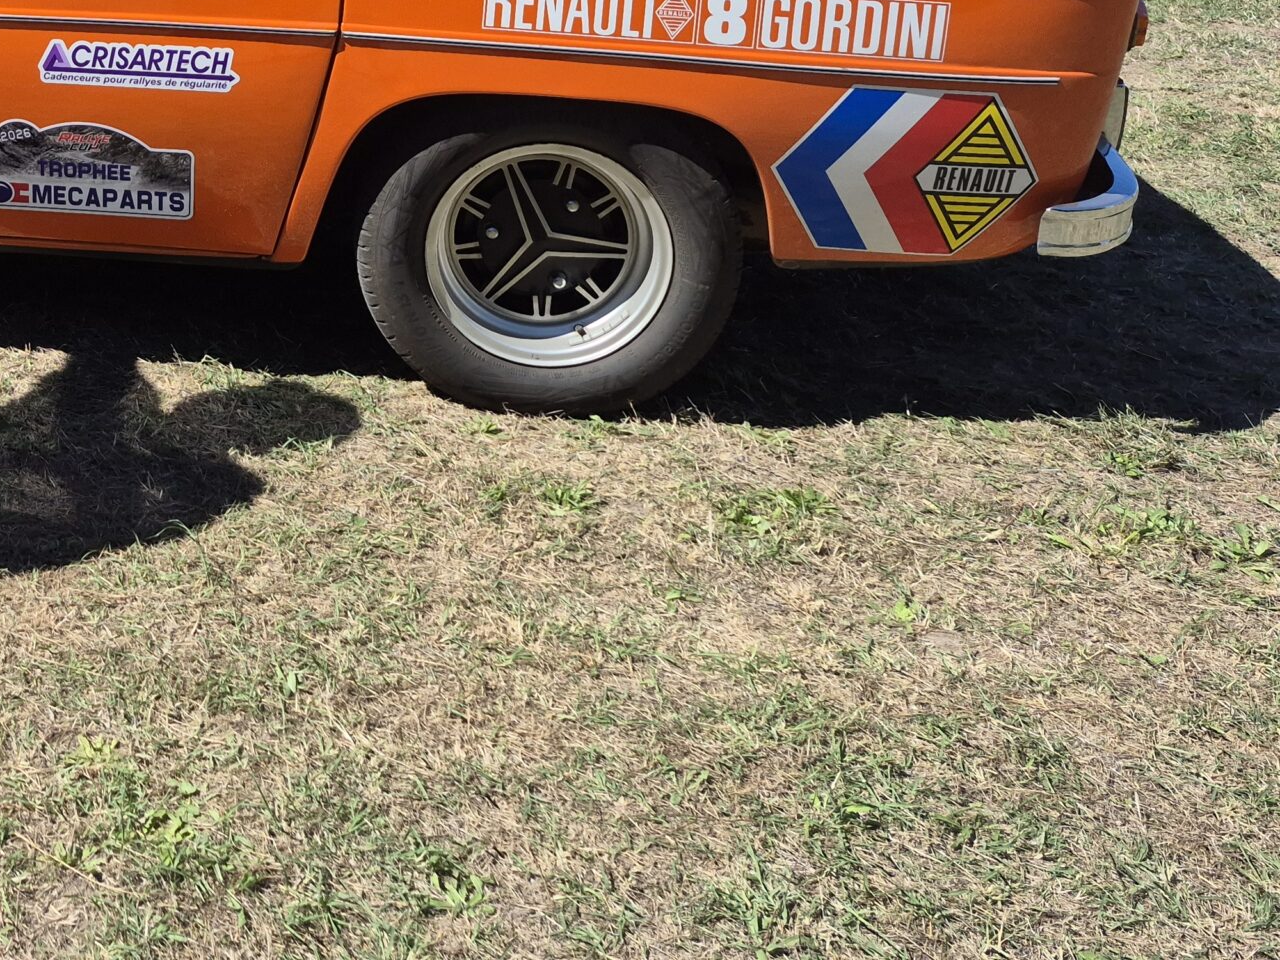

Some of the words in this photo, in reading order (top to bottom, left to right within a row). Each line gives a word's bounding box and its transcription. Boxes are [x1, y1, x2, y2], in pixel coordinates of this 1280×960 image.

[657, 6, 692, 20] RENAULT
[71, 45, 230, 74] CRISARTECH
[43, 72, 101, 83] Cadenceurs
[103, 76, 127, 85] pour
[129, 77, 162, 87] rallyes
[165, 79, 177, 87] de
[179, 80, 228, 91] régularité
[0, 128, 32, 142] 2026
[38, 160, 132, 182] TROPHEE
[932, 165, 1019, 194] RENAULT
[31, 183, 186, 213] MECAPARTS
